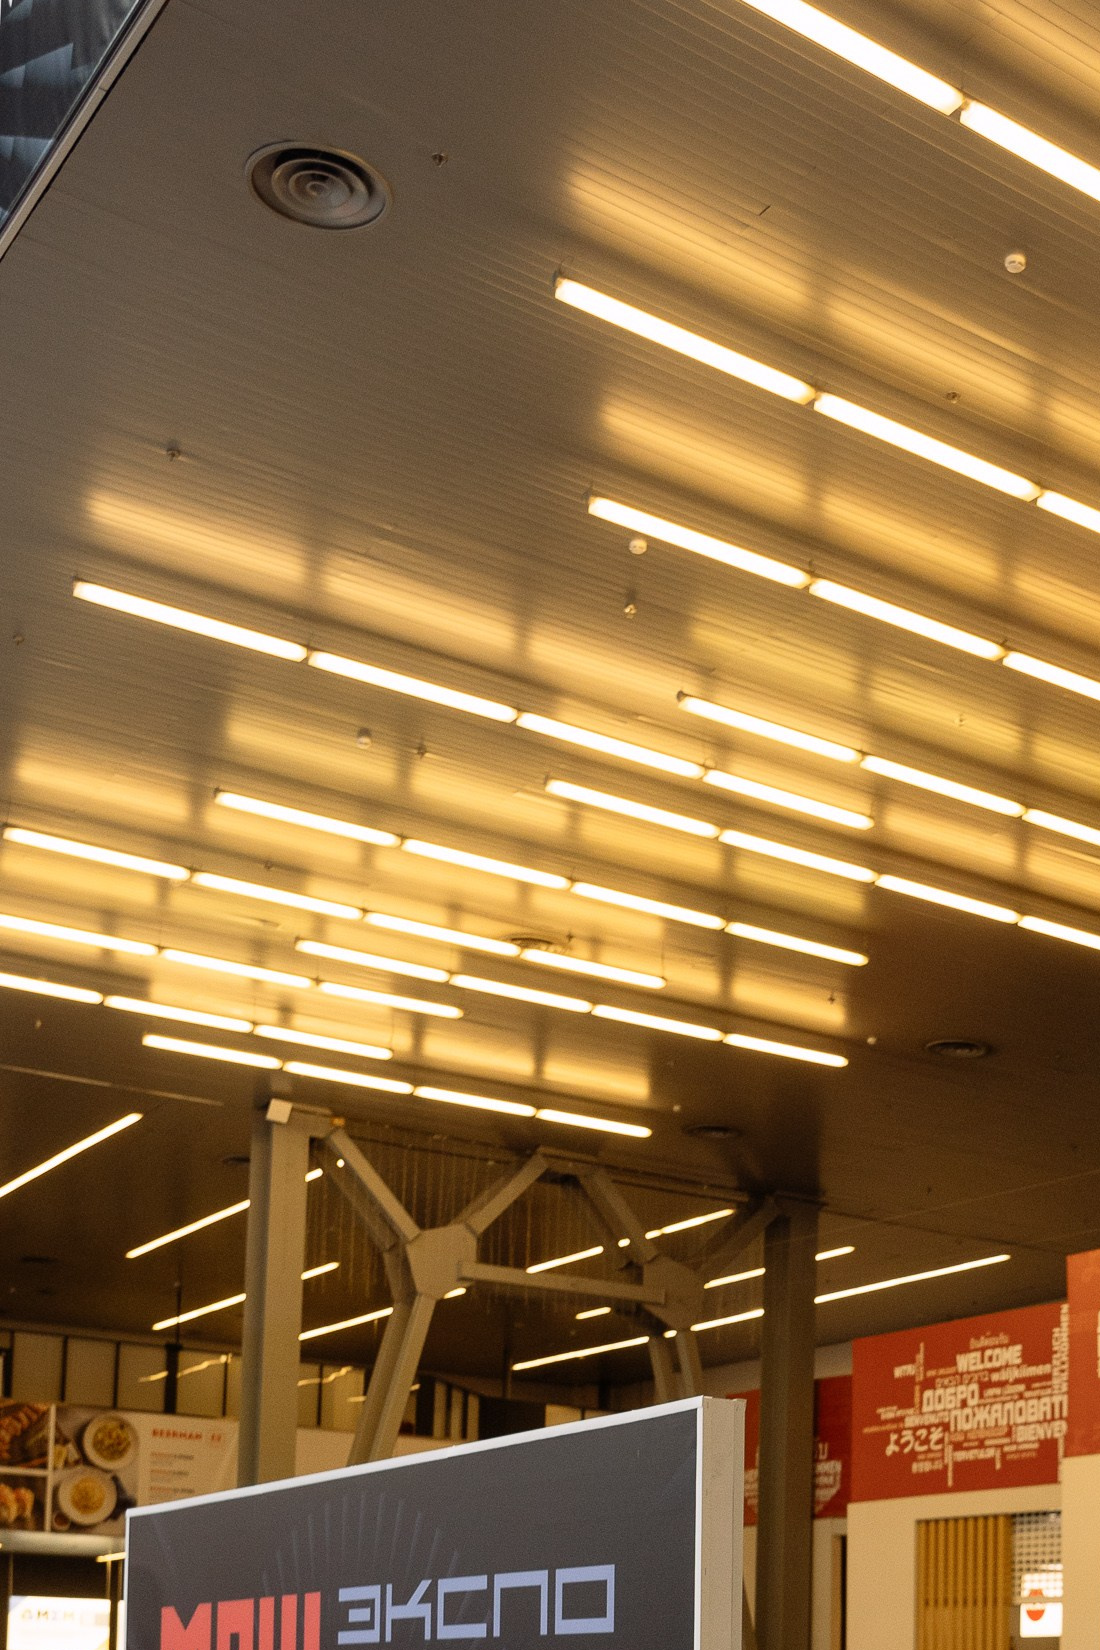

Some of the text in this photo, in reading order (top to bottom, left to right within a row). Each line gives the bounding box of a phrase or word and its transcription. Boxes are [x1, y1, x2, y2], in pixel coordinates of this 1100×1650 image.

[956, 1344, 1022, 1373] WELCOME
[922, 1383, 979, 1413] ДОБРО
[885, 1425, 944, 1457] ようこそ
[337, 1564, 616, 1646] ЭКСПО
